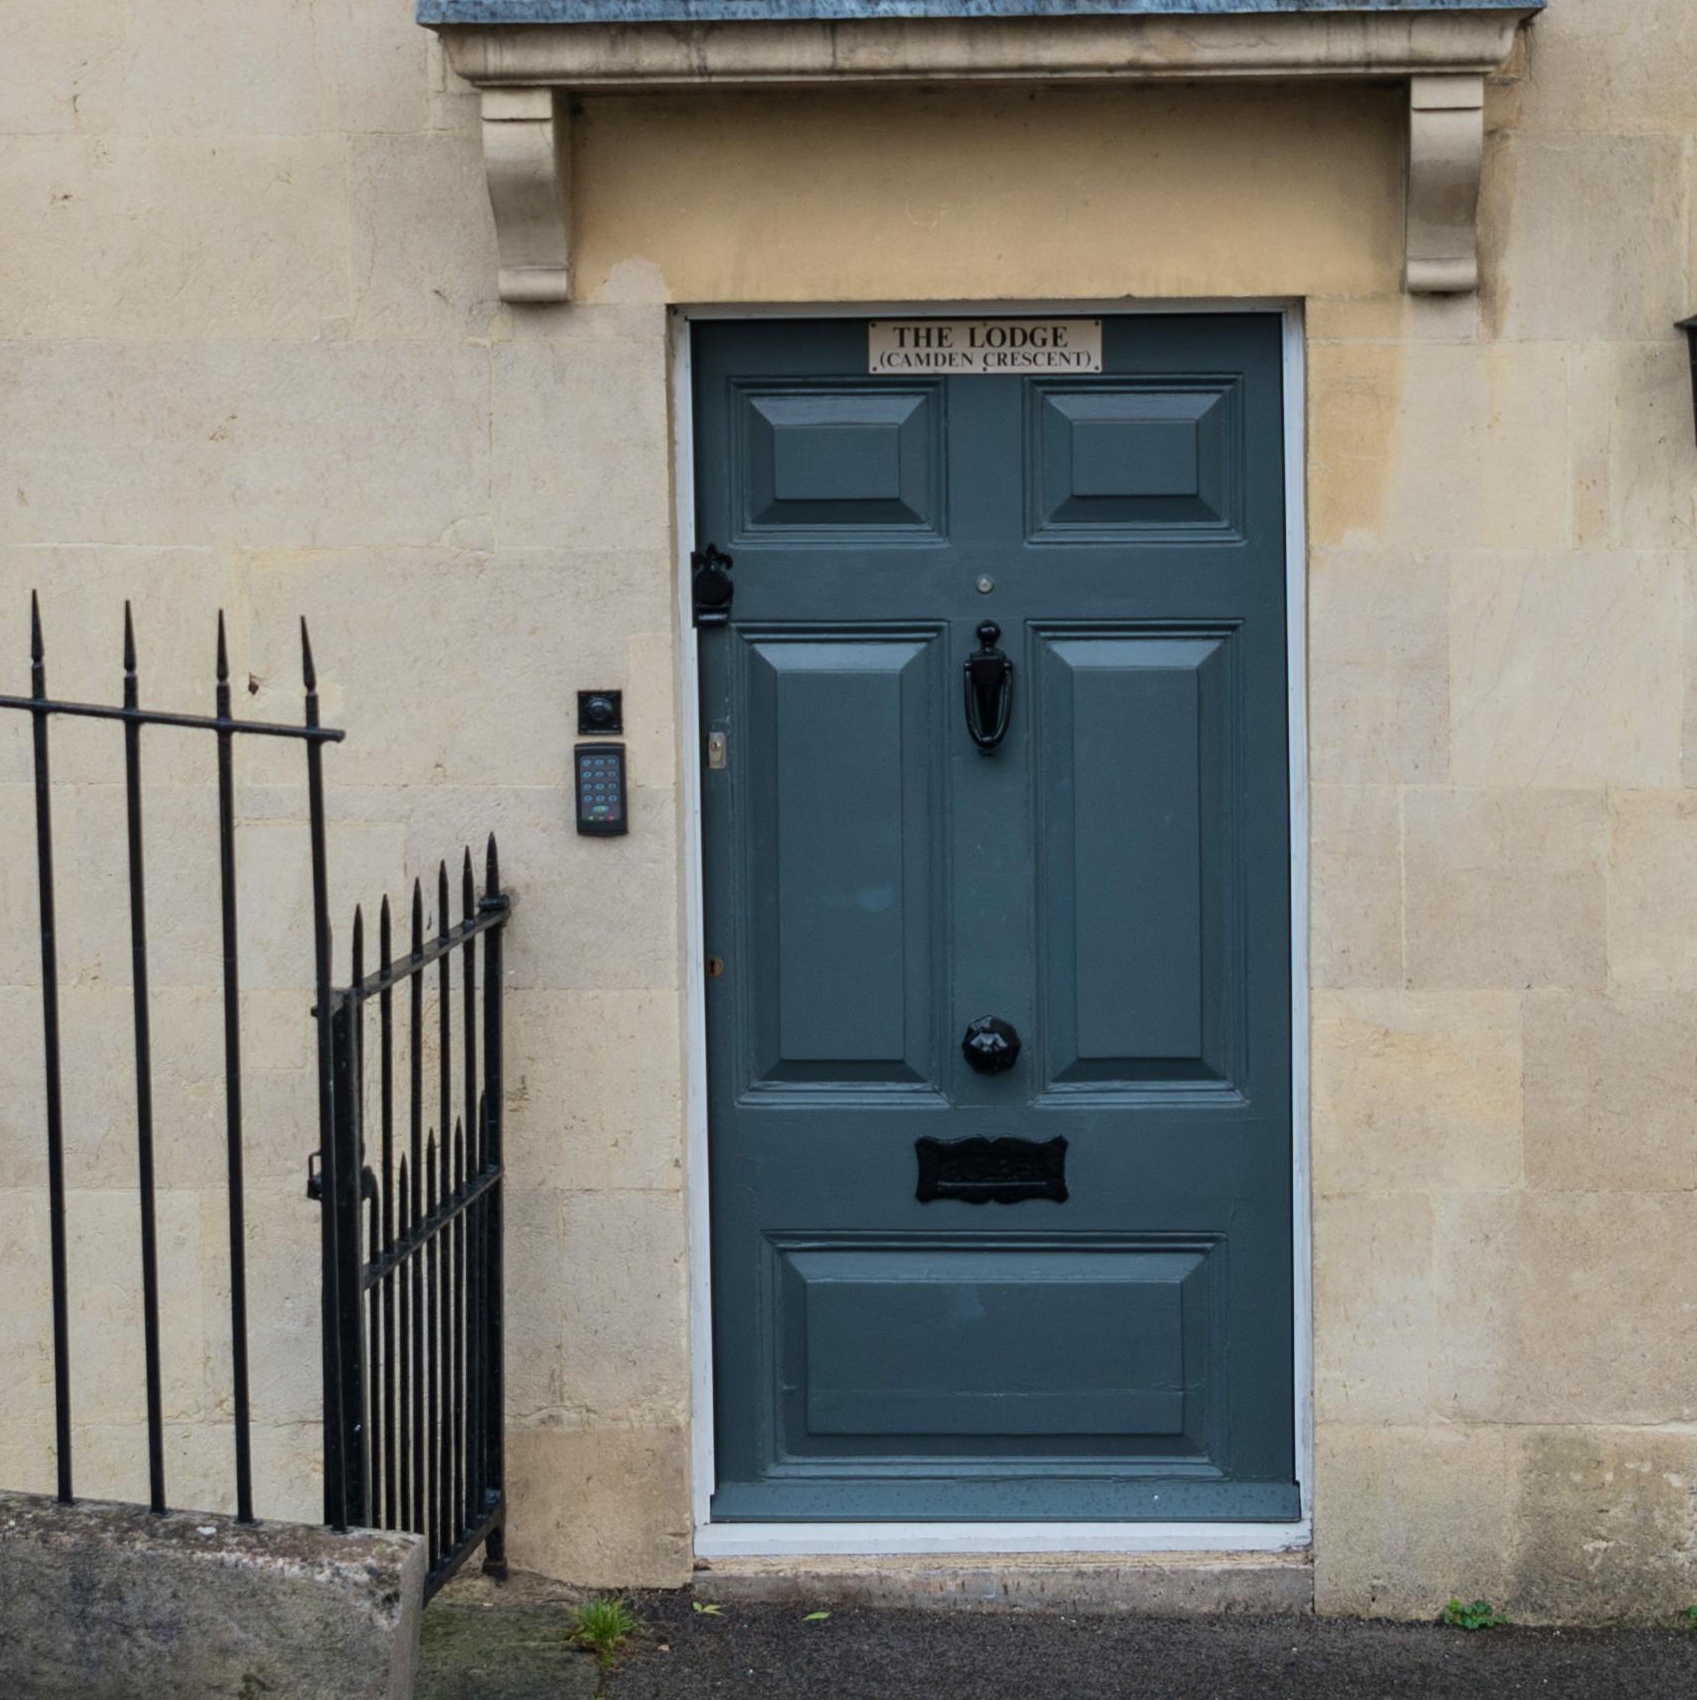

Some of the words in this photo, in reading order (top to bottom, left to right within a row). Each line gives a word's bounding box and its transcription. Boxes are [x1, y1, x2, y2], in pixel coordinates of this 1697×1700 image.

[893, 326, 953, 349] THE
[969, 326, 1068, 348] LODGE
[879, 352, 974, 368] (CAMDEN
[983, 350, 1092, 367] CRESCENT)
